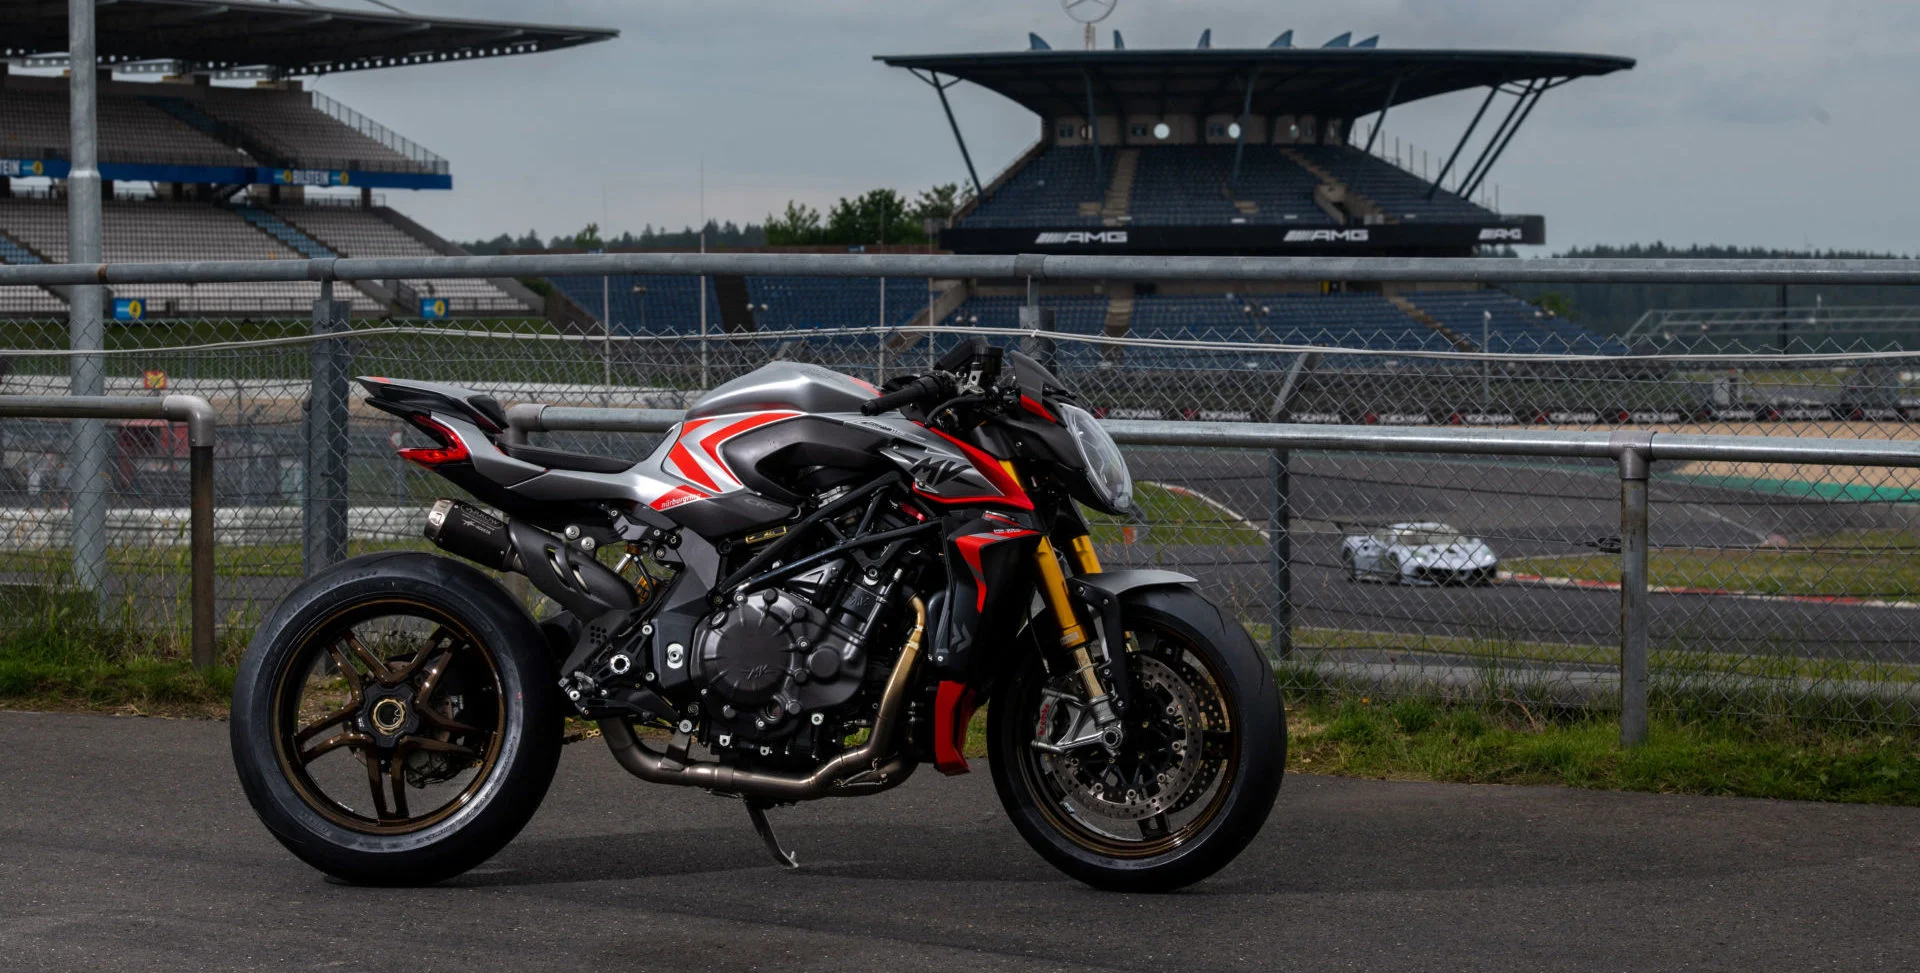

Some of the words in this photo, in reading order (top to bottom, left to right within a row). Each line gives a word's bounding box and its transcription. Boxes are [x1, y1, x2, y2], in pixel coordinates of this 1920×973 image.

[292, 170, 330, 185] BILSTEIN
[1063, 231, 1128, 243] AMG
[1311, 229, 1369, 241] AMG
